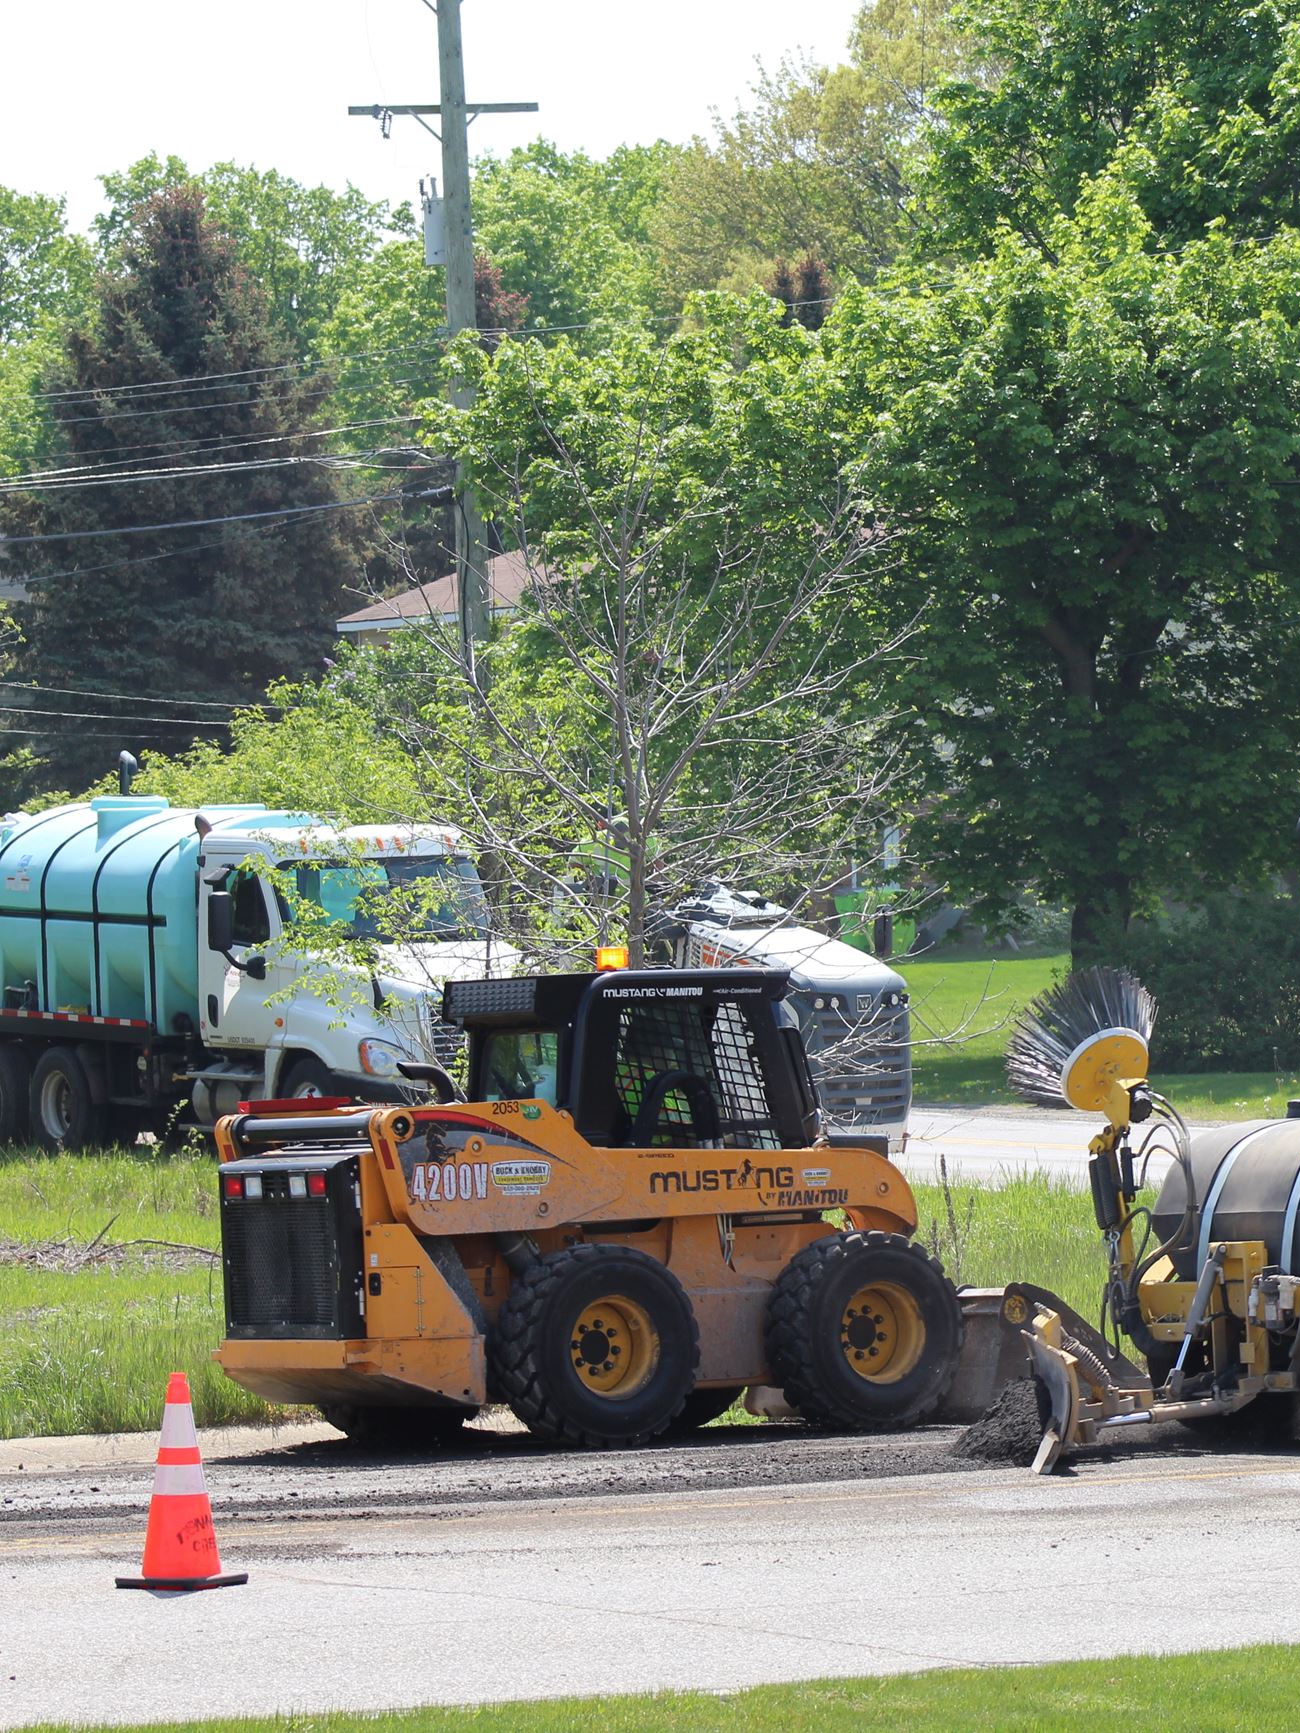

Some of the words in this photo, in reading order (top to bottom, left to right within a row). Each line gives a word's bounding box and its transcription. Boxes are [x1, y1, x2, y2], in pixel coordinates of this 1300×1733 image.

[603, 988, 655, 998] MUSTANG
[666, 987, 703, 996] MANITOU
[492, 1101, 520, 1115] 2053
[495, 1166, 513, 1175] BUCK
[412, 1162, 488, 1200] 4200V
[778, 1188, 849, 1207] MANITOU
